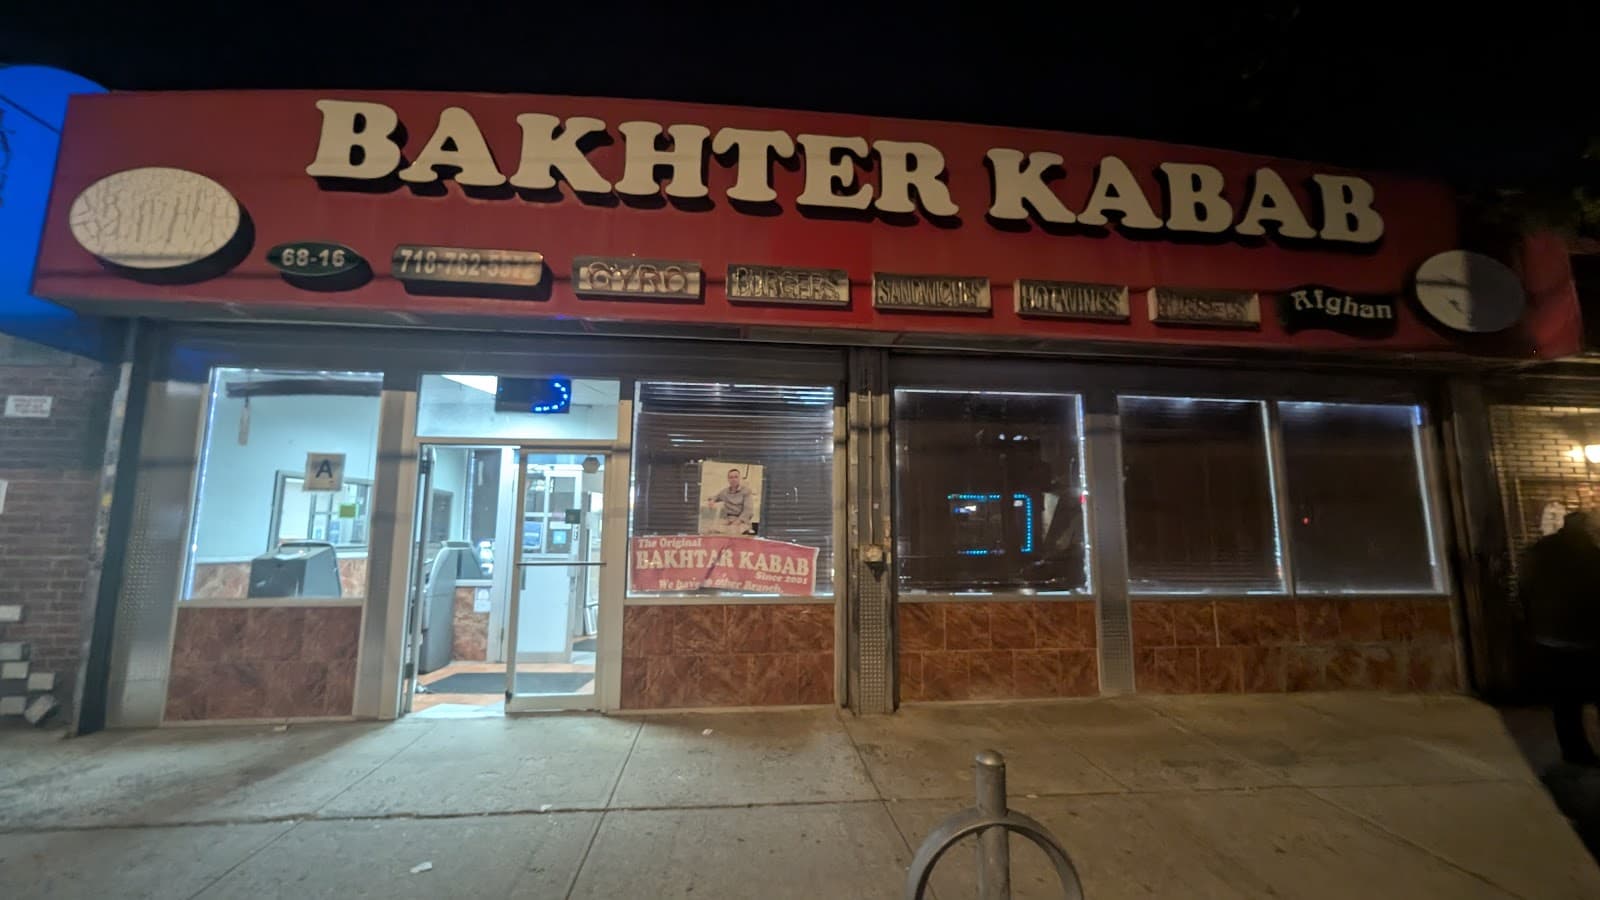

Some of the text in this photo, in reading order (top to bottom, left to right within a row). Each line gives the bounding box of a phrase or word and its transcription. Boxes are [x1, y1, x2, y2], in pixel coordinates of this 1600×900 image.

[306, 100, 1383, 242] BAKHTER KABAB
[282, 248, 345, 267] 68-16
[1291, 289, 1392, 319] Afghan
[315, 459, 333, 478] A
[638, 537, 702, 549] The Original
[636, 549, 809, 576] BAKHTAR KABAB
[755, 571, 782, 582] Since
